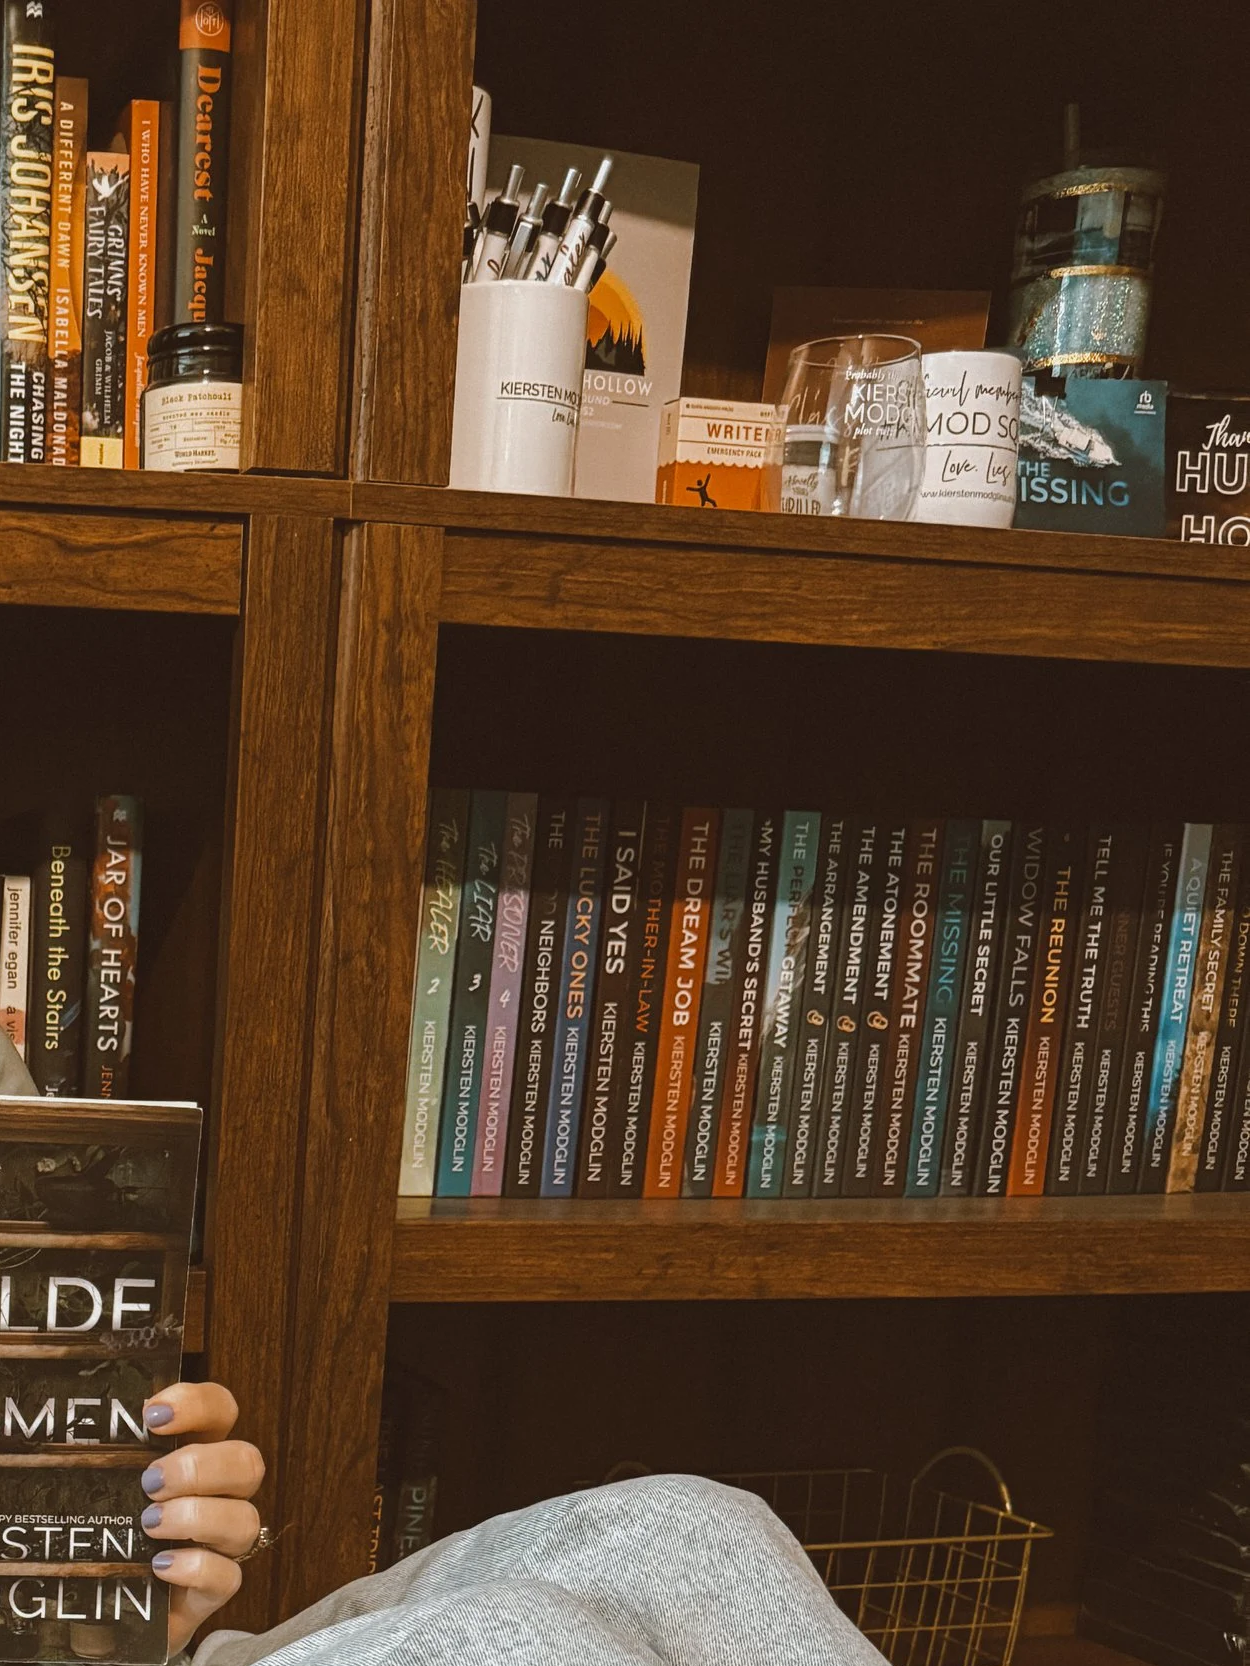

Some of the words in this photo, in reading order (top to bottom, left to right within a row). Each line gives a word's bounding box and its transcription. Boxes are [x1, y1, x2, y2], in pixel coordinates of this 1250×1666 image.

[11, 43, 55, 127] IRIS
[139, 130, 151, 163] WHO
[192, 63, 223, 203] Dearest
[57, 119, 74, 214] DIFFERENT
[139, 168, 149, 205] HAVE
[7, 134, 52, 344] JOHANSEN
[57, 217, 72, 269] DAWN
[89, 205, 104, 248] FAIRY
[137, 208, 149, 250] NEVER
[86, 258, 103, 319] TALES
[137, 253, 148, 301] KNOWN
[30, 370, 44, 463] CHASING
[500, 381, 563, 400] KIERSTEN
[707, 447, 744, 457] EMERGENCY
[746, 449, 762, 458] PACK
[1020, 477, 1129, 507] ISSING
[48, 845, 71, 938] Beneath
[106, 836, 128, 886] JAR
[612, 851, 635, 915] SAID
[7, 886, 23, 947] jennifer
[103, 898, 126, 939] OF
[468, 879, 497, 944] LIAR
[678, 878, 704, 970] DREAM
[744, 861, 770, 974] HUSBAND'S
[979, 881, 1000, 941] LITTLE
[7, 951, 19, 990] egan
[47, 944, 70, 982] the
[531, 919, 554, 1034] NEIGHBORS
[605, 923, 627, 975] YES
[899, 893, 931, 1030] ROOMMATE
[970, 944, 991, 1017] SECRET
[1008, 934, 1031, 1008] FALLS
[1041, 918, 1066, 1025] REUNION
[97, 947, 123, 1052] HEARTS
[672, 977, 694, 1028] JOB
[774, 955, 795, 1050] GETAWAY
[1169, 939, 1193, 1025] RETREAT
[44, 988, 67, 1051] Stairs
[595, 1001, 618, 1093] KIERSTEN
[587, 1094, 608, 1183] MODGLIN
[658, 1113, 677, 1189] MODGLIN
[14, 1513, 85, 1525] BESTSELLING
[87, 1515, 133, 1526] AUTHOR
